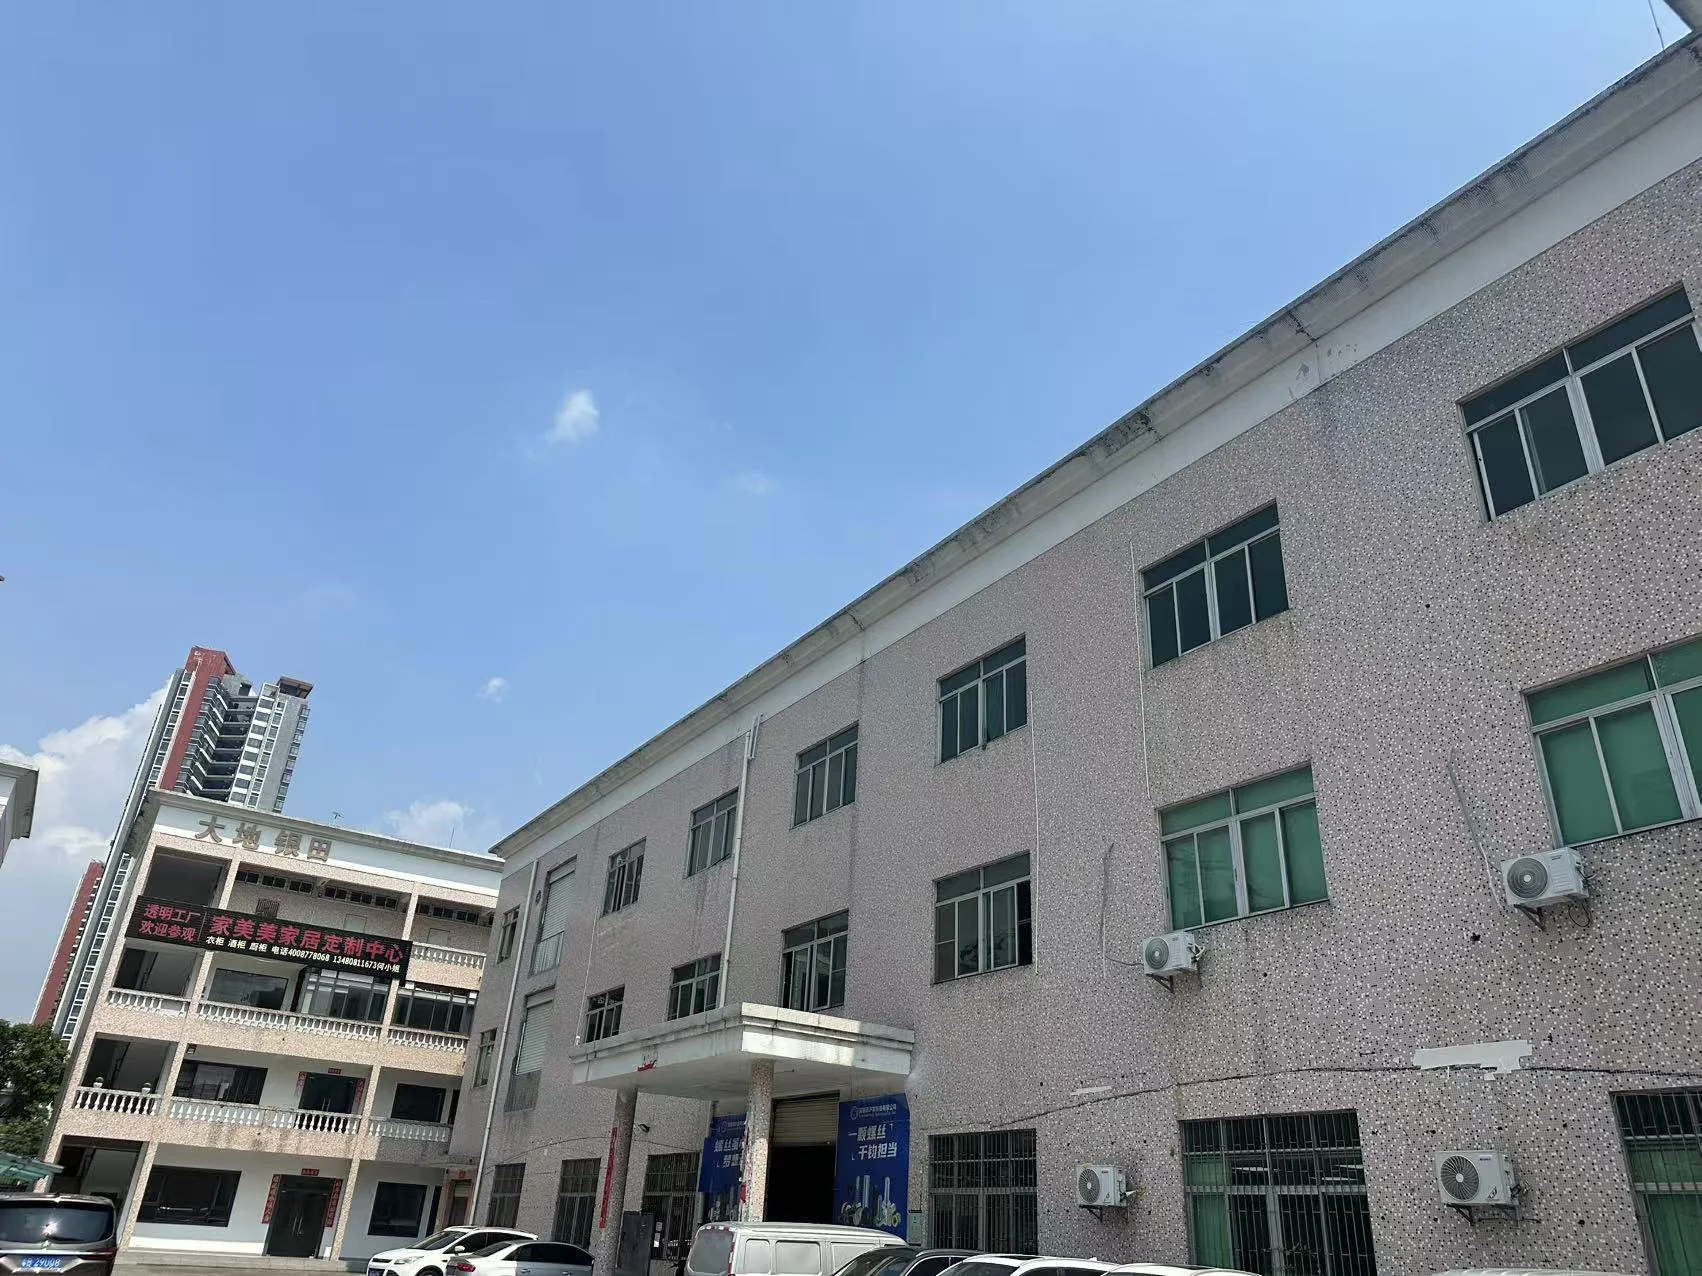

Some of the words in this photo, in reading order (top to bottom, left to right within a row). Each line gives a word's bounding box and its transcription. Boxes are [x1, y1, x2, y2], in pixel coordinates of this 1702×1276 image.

[143, 903, 201, 924] 透明工厂
[139, 920, 196, 942] 欢迎参观
[209, 915, 404, 963] 家美美家居定制中心
[205, 935, 225, 946] 衣柜
[227, 938, 247, 950] 酒柜
[848, 1123, 886, 1142] 一颗螺丝
[858, 1141, 898, 1161] 千钧担当
